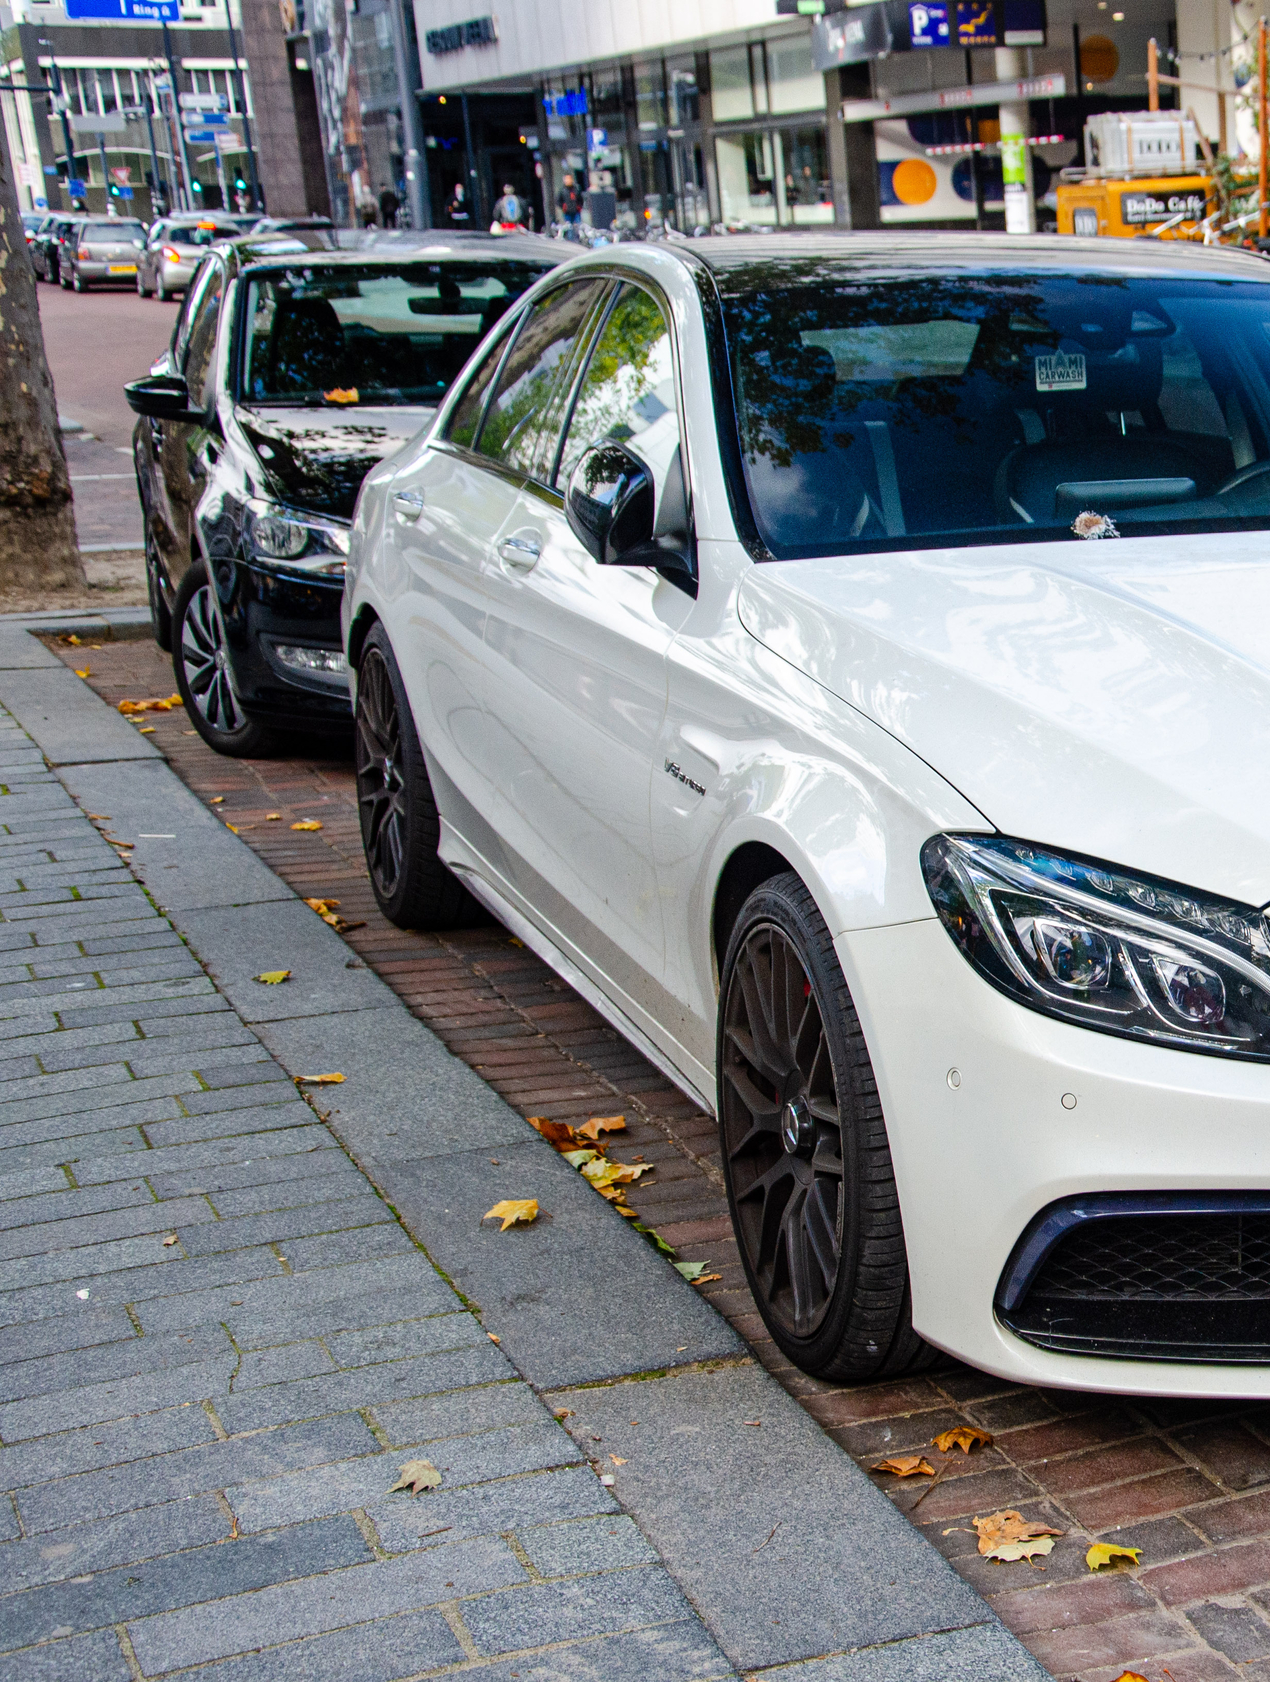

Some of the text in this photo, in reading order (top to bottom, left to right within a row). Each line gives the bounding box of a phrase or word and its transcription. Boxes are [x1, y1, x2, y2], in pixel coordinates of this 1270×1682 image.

[132, 3, 161, 20] Ring
[1038, 350, 1084, 371] MIAMI
[1039, 370, 1083, 381] CARWASH
